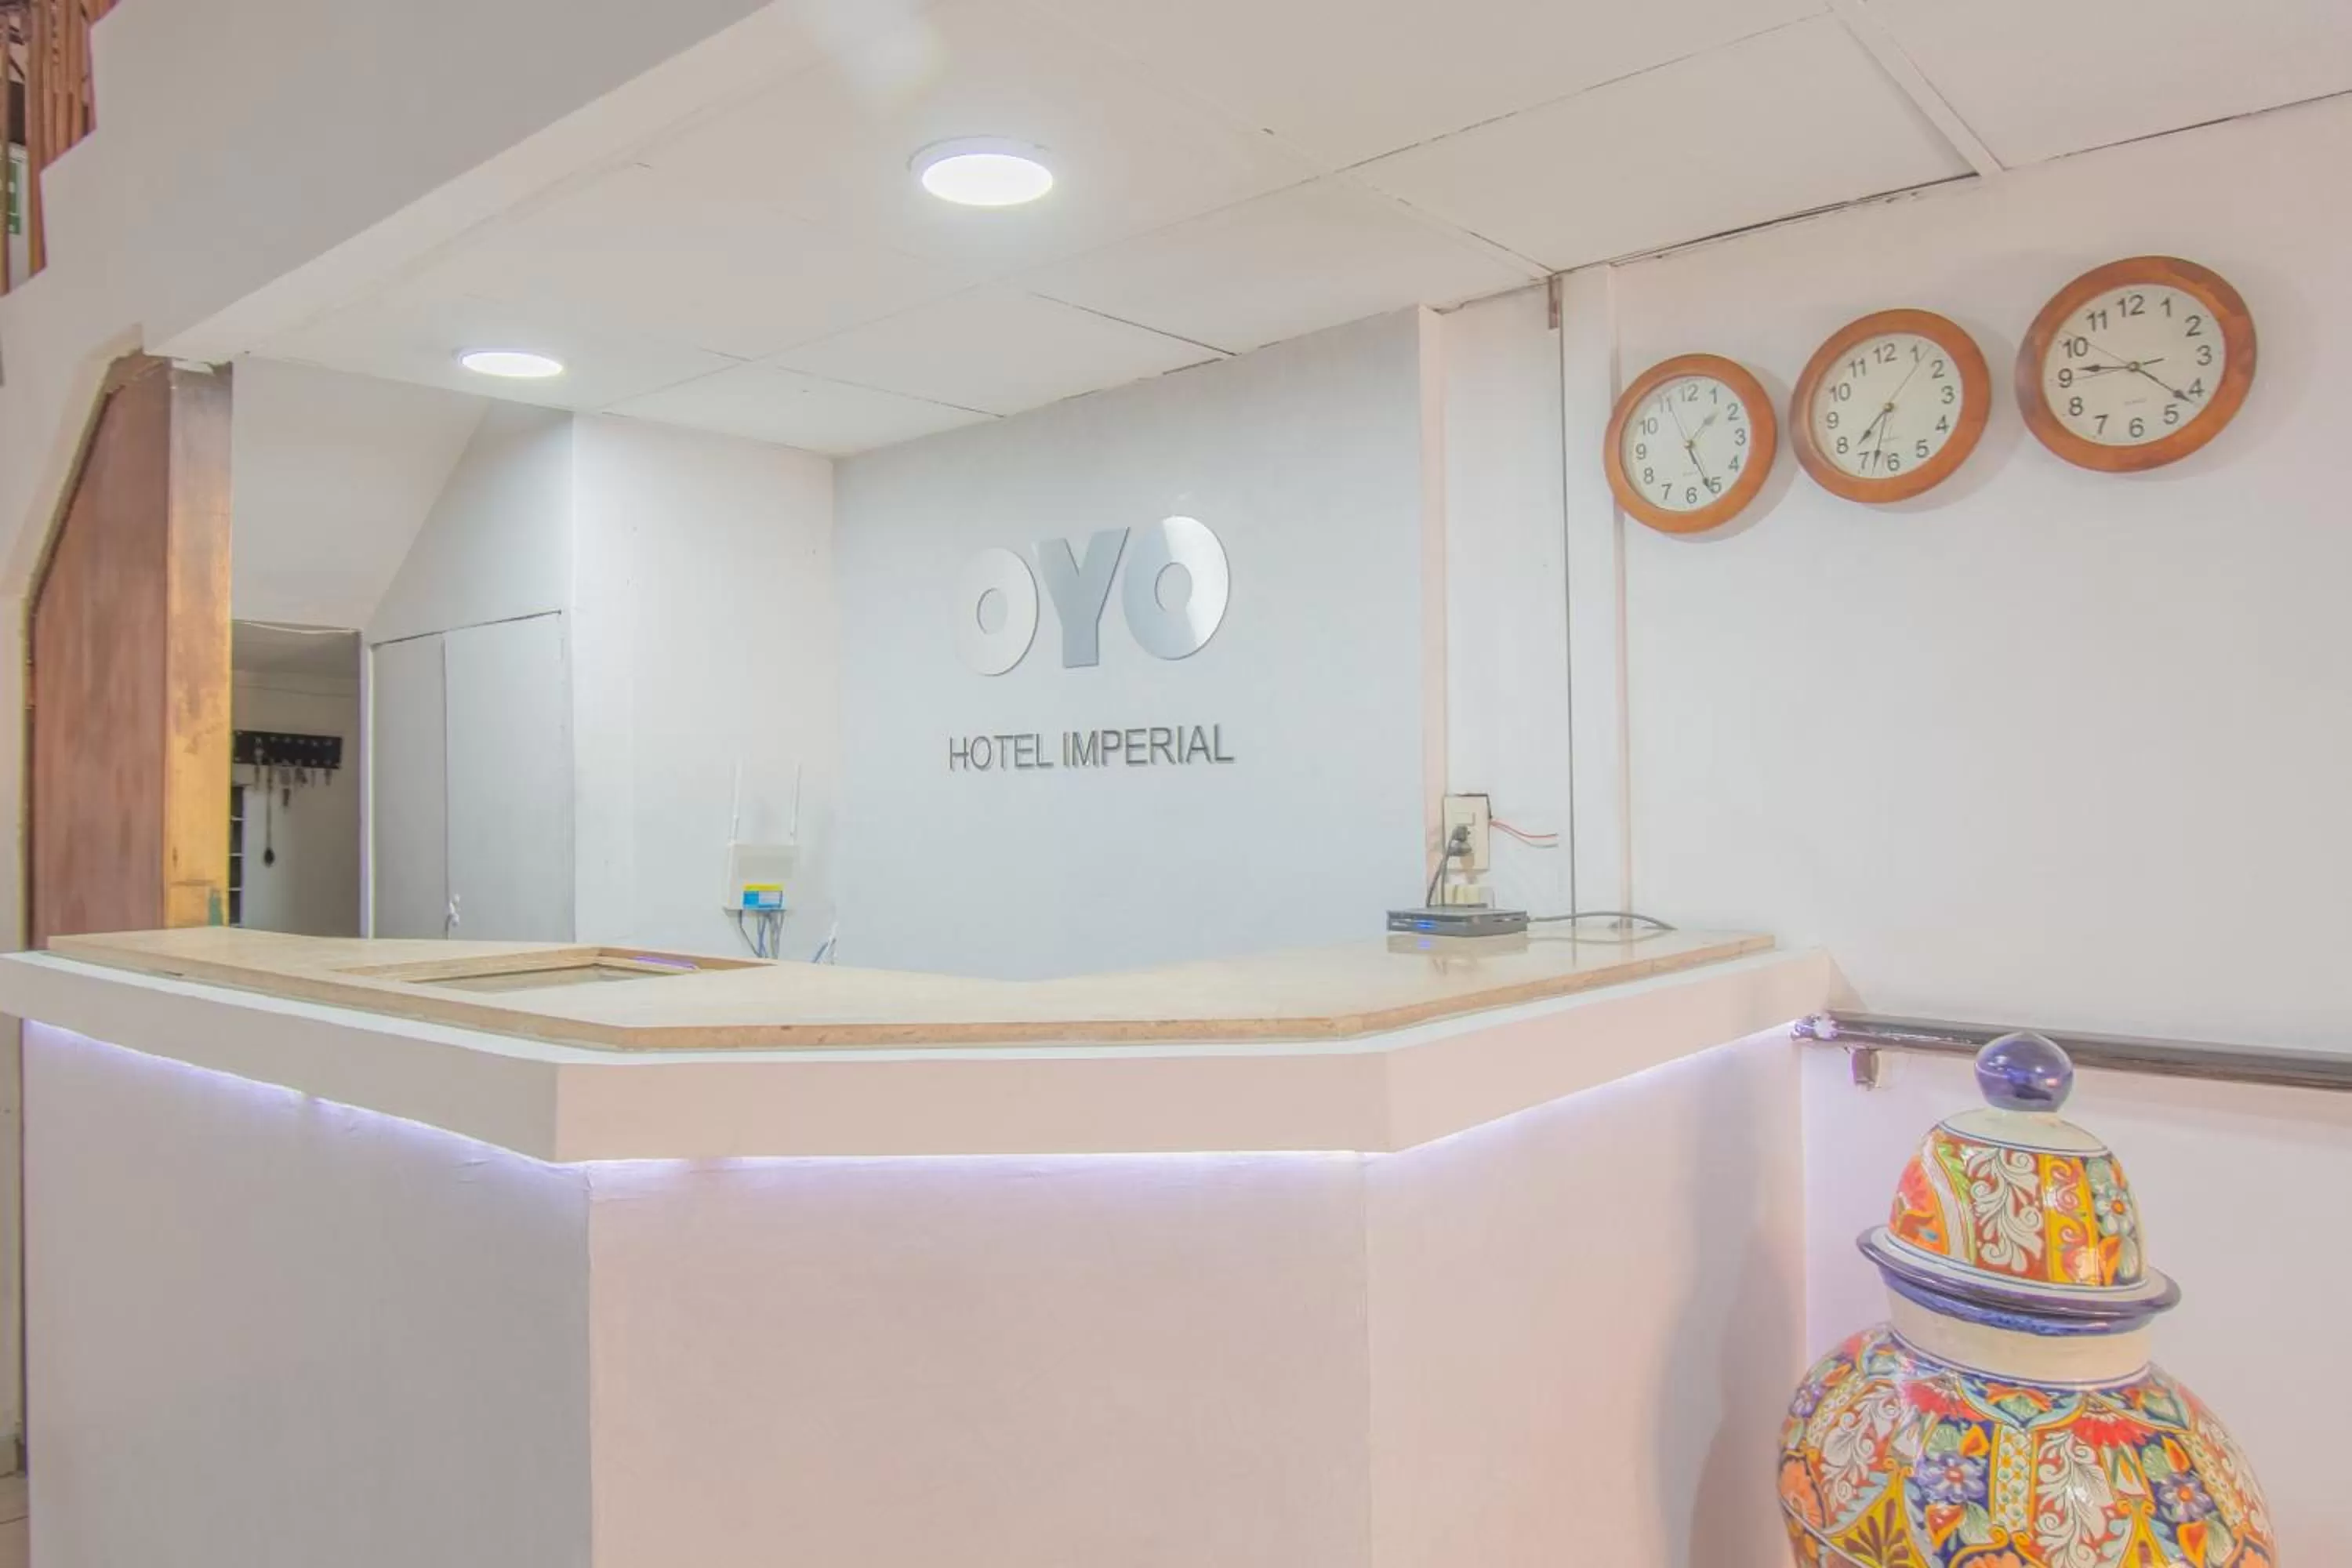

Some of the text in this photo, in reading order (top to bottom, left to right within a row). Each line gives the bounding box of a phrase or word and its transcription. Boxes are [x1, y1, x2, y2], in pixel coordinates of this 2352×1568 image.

[2117, 293, 2146, 318] 12
[2160, 297, 2171, 317] 1
[2086, 310, 2107, 332] 11
[2184, 315, 2201, 337] 2
[1873, 343, 1897, 364] 12
[1910, 345, 1919, 364] 1
[2062, 336, 2089, 358] 10
[2196, 344, 2212, 366] 3
[1848, 358, 1867, 378] 11
[1931, 360, 1945, 379] 2
[2057, 368, 2073, 389] 9
[2188, 378, 2205, 398] 4
[1679, 383, 1700, 402] 12
[1710, 387, 1718, 405] 1
[1829, 383, 1851, 402] 10
[1941, 385, 1955, 405] 3
[1658, 394, 1672, 414] 11
[1726, 402, 1739, 421] 2
[2068, 396, 2084, 416] 8
[1826, 412, 1838, 430] 9
[2163, 404, 2180, 424] 5
[1639, 417, 1658, 435] 10
[1935, 415, 1950, 434] 4
[2094, 414, 2108, 435] 7
[2129, 417, 2145, 438] 6
[1734, 428, 1746, 446] 3
[1836, 436, 1849, 455] 8
[1635, 443, 1646, 460] 9
[1915, 439, 1930, 458] 5
[1729, 455, 1739, 472] 4
[1857, 452, 1870, 470] 7
[1887, 452, 1900, 471] 6
[1643, 466, 1654, 485] 8
[1661, 483, 1673, 500] 7
[1686, 486, 1697, 504] 6
[1710, 477, 1722, 494] 5
[954, 515, 1231, 677] OYO
[949, 724, 1236, 772] HOTEL IMPERIAL
